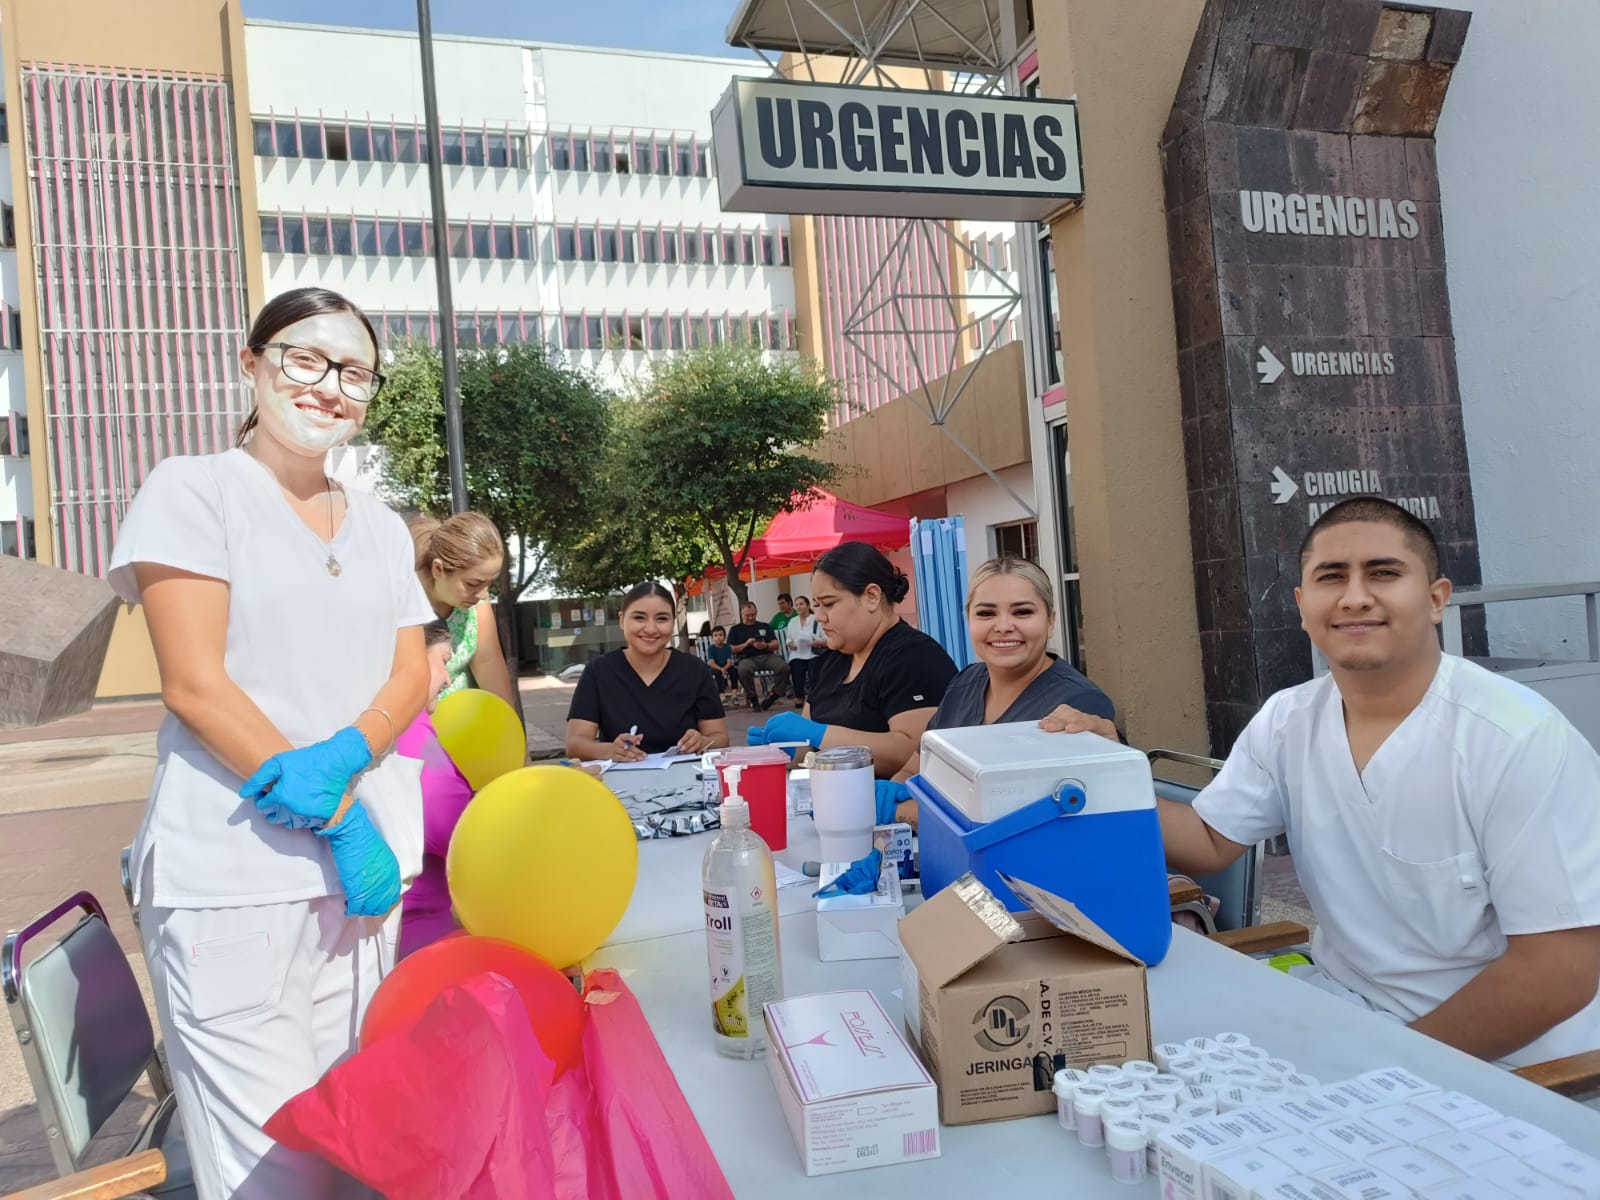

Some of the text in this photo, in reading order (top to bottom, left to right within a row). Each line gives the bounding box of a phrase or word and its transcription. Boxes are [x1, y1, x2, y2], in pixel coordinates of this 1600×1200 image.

[756, 97, 1067, 181] URGENCIAS
[1240, 190, 1419, 239] URGENCIAS
[1291, 351, 1395, 376] URGENCIAS
[1304, 470, 1382, 496] CIRUGIA
[1041, 1000, 1051, 1018] DE
[1042, 1022, 1053, 1047] C.V.
